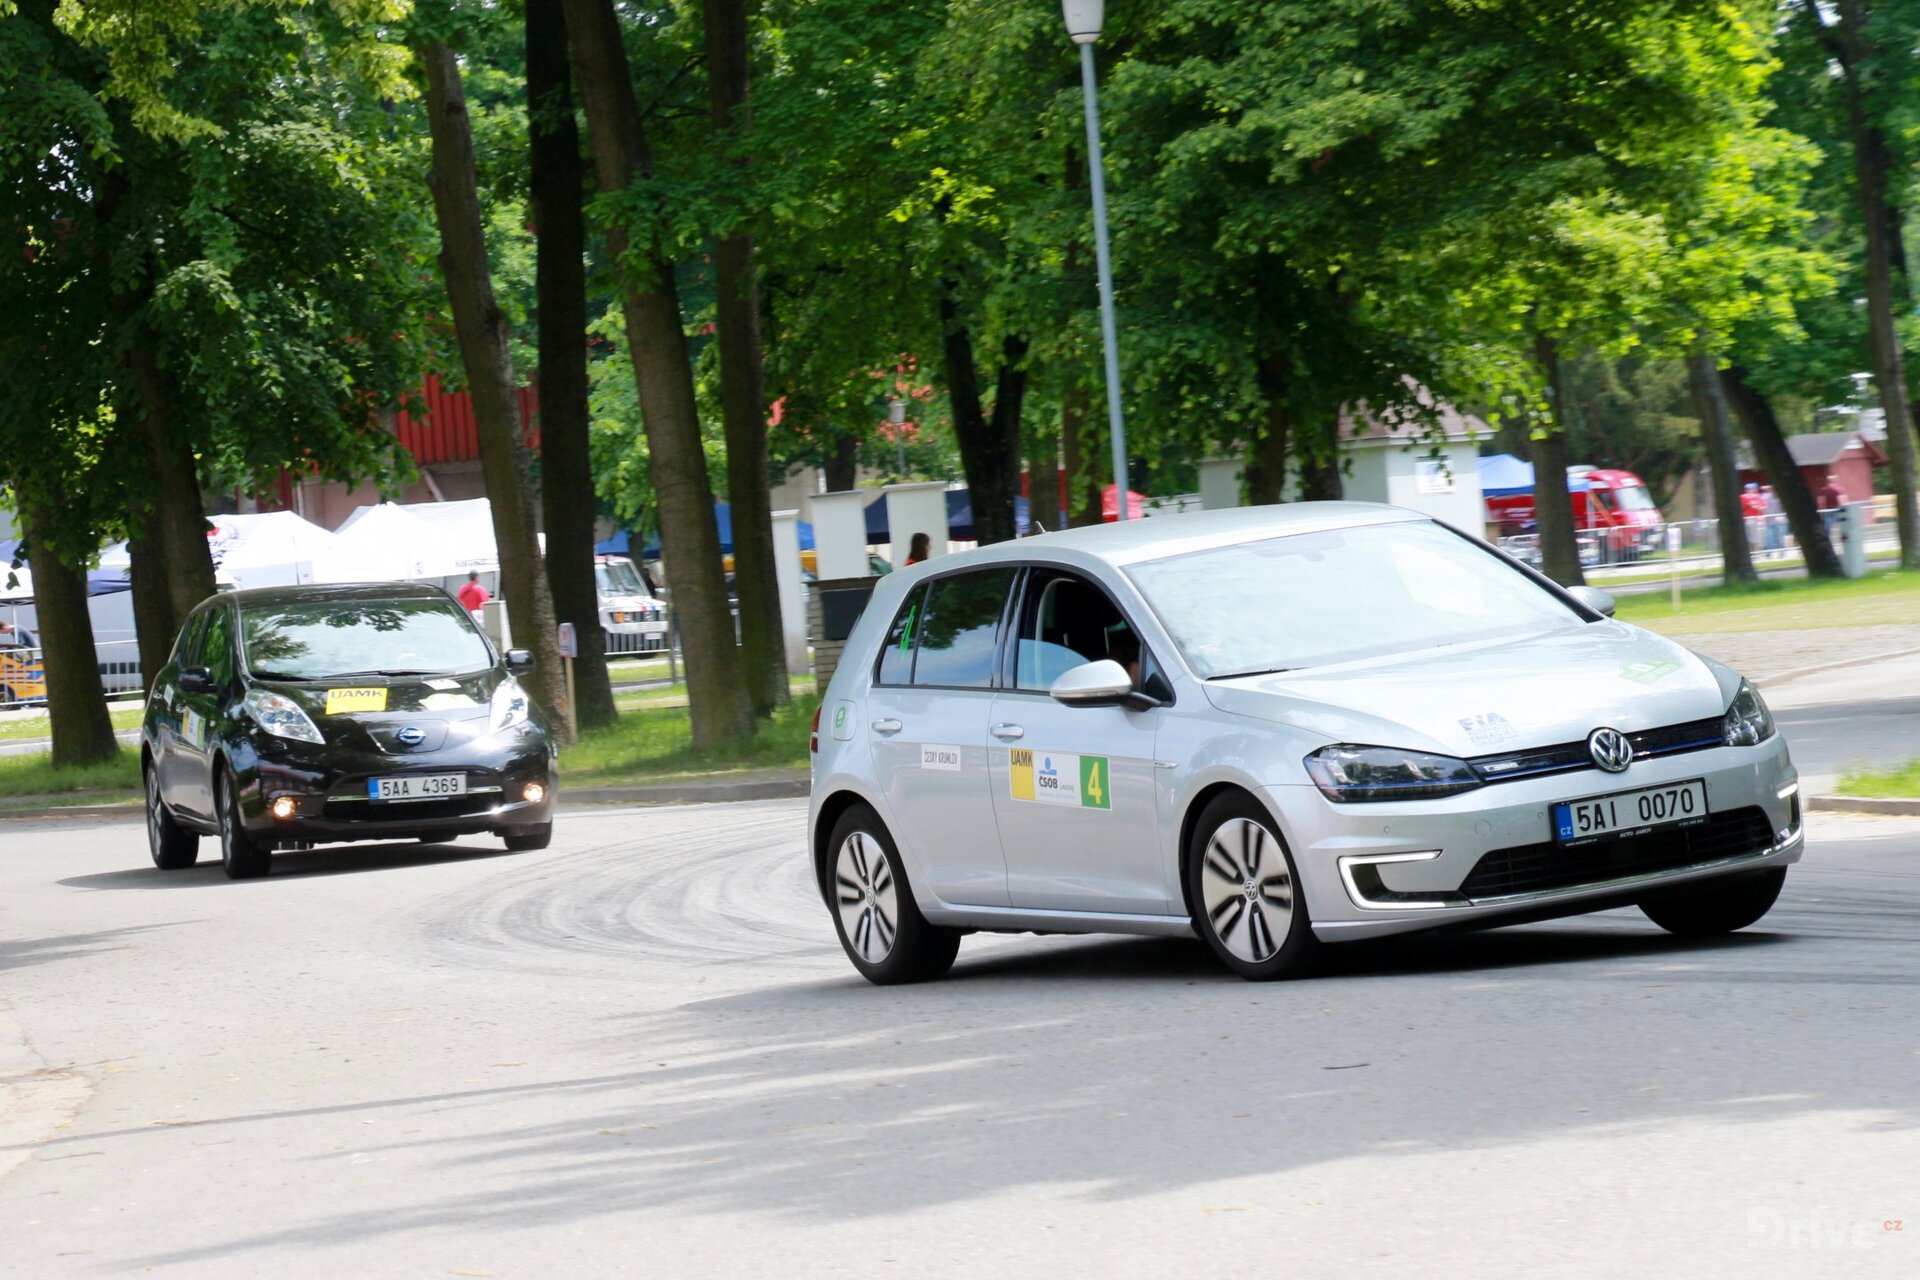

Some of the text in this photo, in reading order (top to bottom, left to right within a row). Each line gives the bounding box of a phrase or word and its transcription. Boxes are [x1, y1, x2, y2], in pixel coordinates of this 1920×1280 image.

[331, 689, 383, 699] UAMK
[1011, 749, 1034, 768] UAMK
[381, 777, 459, 797] 5AA 4369
[1038, 775, 1058, 789] ČSOB
[1087, 761, 1103, 805] 4
[1576, 788, 1694, 832] 5AI 0070
[1560, 825, 1572, 836] CZ
